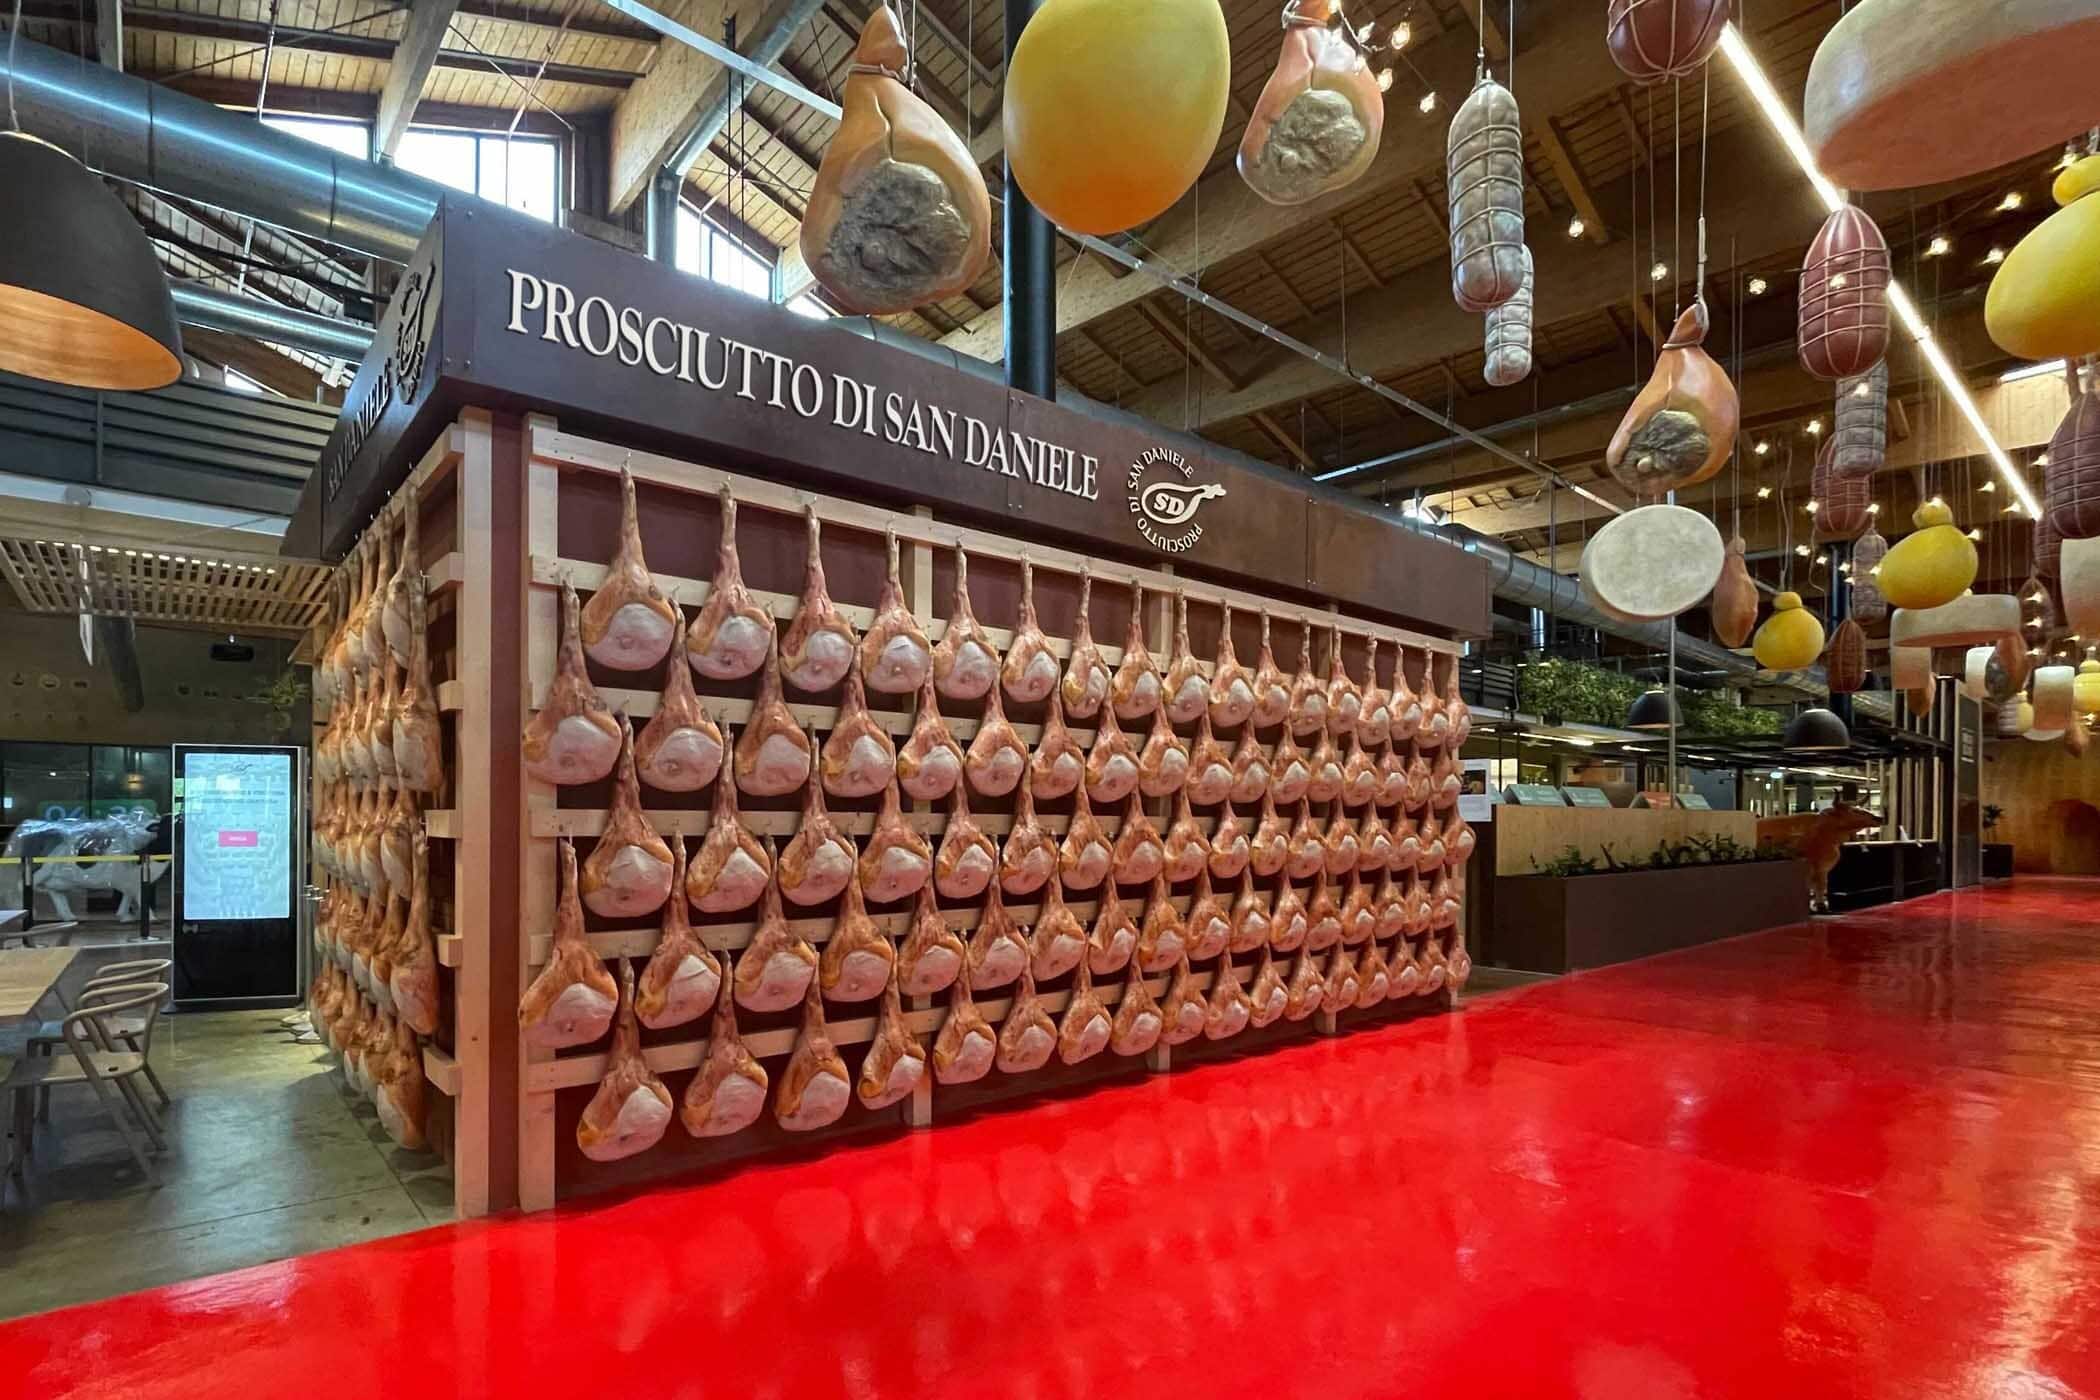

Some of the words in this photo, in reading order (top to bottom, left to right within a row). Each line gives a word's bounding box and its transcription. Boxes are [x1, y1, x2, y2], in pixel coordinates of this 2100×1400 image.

[506, 268, 824, 417] PROSCIUTTO
[831, 373, 877, 437] DI
[884, 392, 957, 460] SAN
[963, 416, 1099, 501] DANIELE
[1127, 459, 1144, 491] SAN
[1142, 447, 1194, 479] DANIELE
[1128, 496, 1141, 512] DI
[1153, 492, 1185, 516] SD
[1137, 518, 1203, 552] PROSCIUTTO
